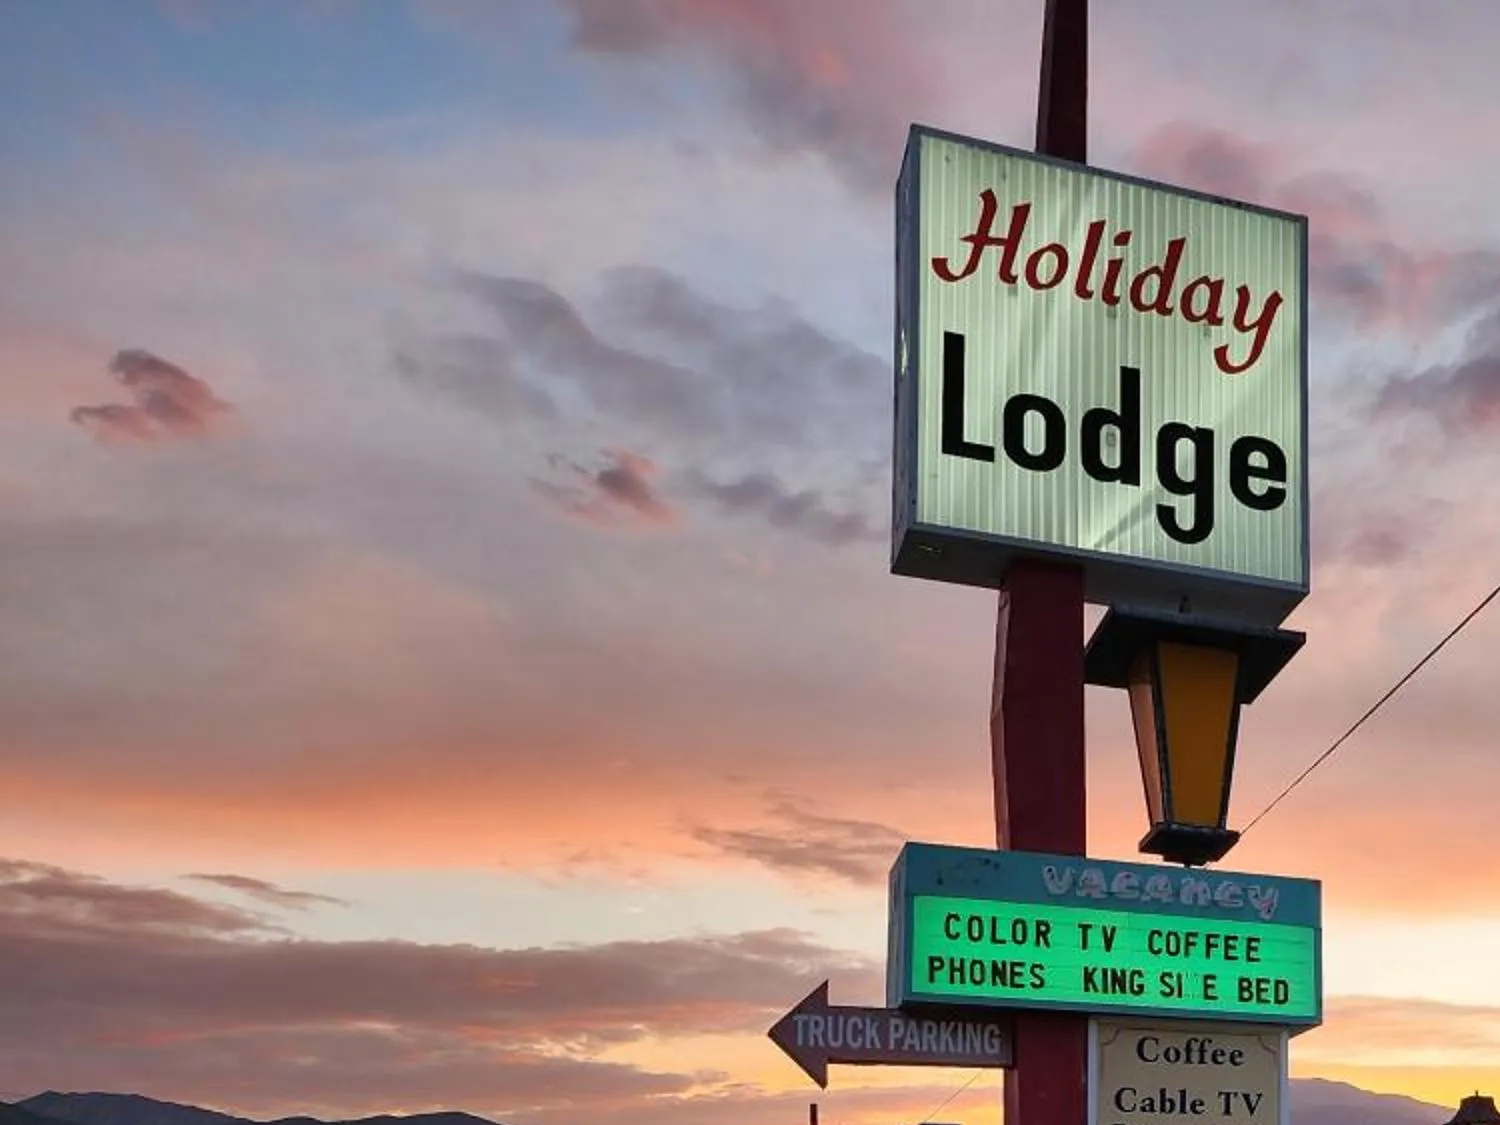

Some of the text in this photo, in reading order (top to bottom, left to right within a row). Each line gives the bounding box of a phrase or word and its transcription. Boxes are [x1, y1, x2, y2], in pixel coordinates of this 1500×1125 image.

[931, 188, 1284, 375] Holiday
[941, 331, 1288, 545] Lodge
[944, 912, 1262, 963] COLOR TV COFFEE
[928, 955, 1289, 1005] PHONES KING SIE BED
[792, 1013, 1000, 1055] TRUCK PARKING
[1136, 1036, 1245, 1066] Coffee
[1114, 1087, 1263, 1117] Cable TV
